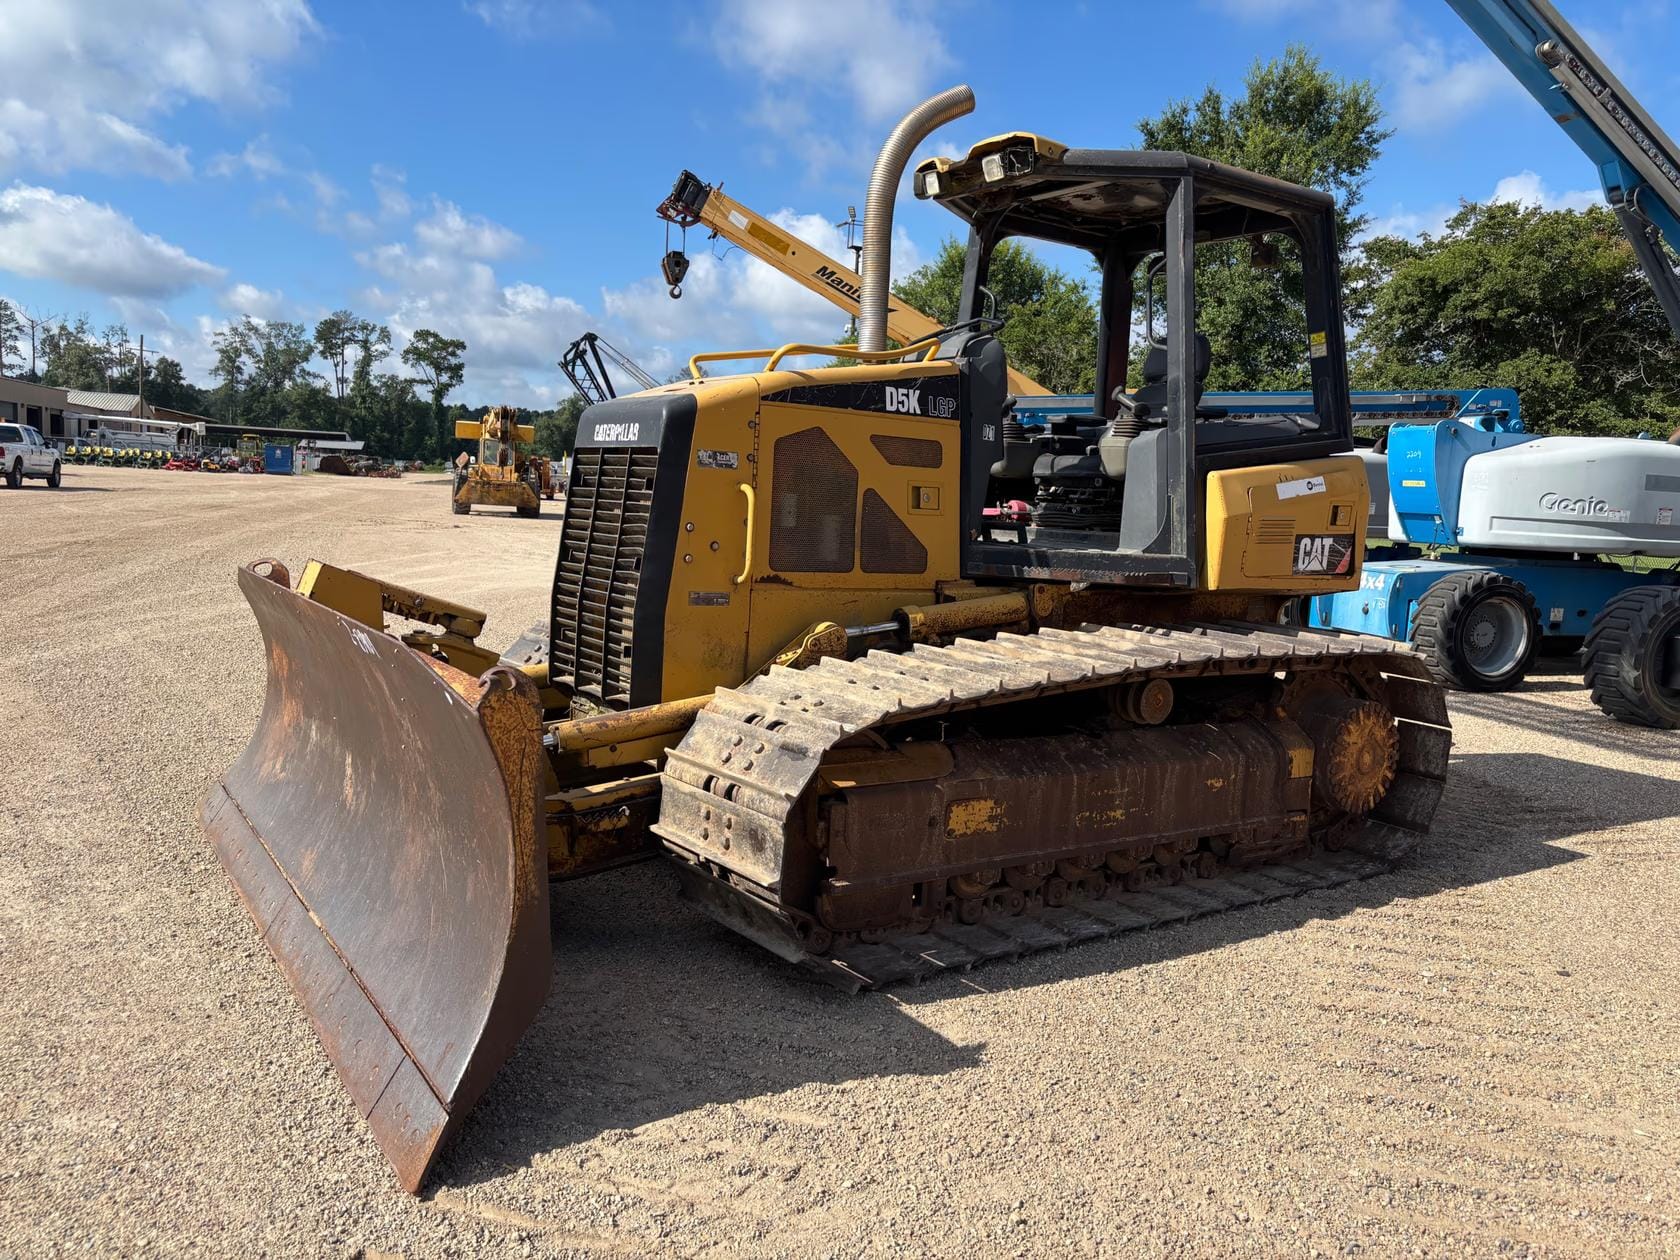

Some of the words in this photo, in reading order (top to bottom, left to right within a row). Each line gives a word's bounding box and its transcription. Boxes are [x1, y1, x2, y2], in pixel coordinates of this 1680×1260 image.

[815, 265, 861, 299] Mani
[885, 386, 922, 415] D5K
[928, 395, 957, 418] LGP
[594, 422, 640, 441] CATERPILLAR
[1538, 491, 1609, 517] Genie
[1298, 537, 1334, 571] CAT
